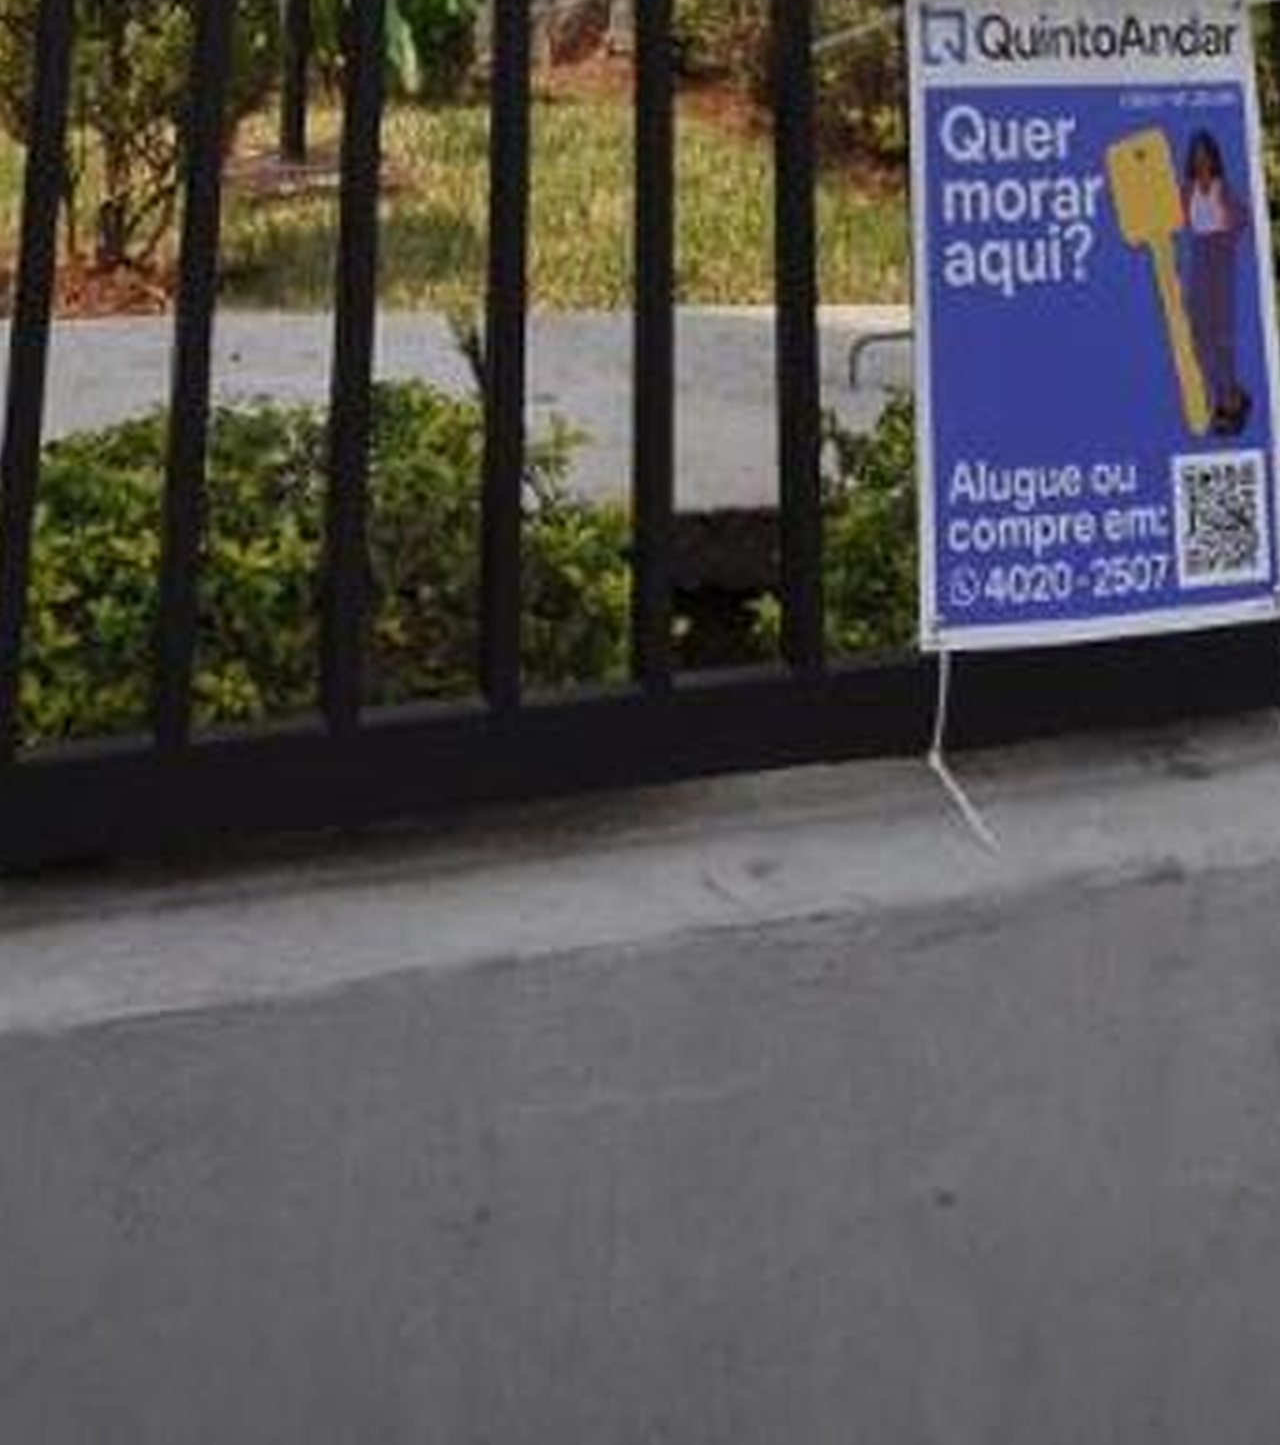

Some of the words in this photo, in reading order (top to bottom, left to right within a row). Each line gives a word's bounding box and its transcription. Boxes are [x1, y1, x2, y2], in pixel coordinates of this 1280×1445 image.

[975, 13, 1237, 62] QuintoAndar
[941, 104, 1076, 162] Quer
[944, 176, 1103, 222] morar
[944, 223, 1093, 297] aqui?
[949, 461, 1081, 512] Alugue
[1091, 464, 1136, 496] ou
[948, 511, 1096, 556] compre
[1104, 504, 1168, 542] em:
